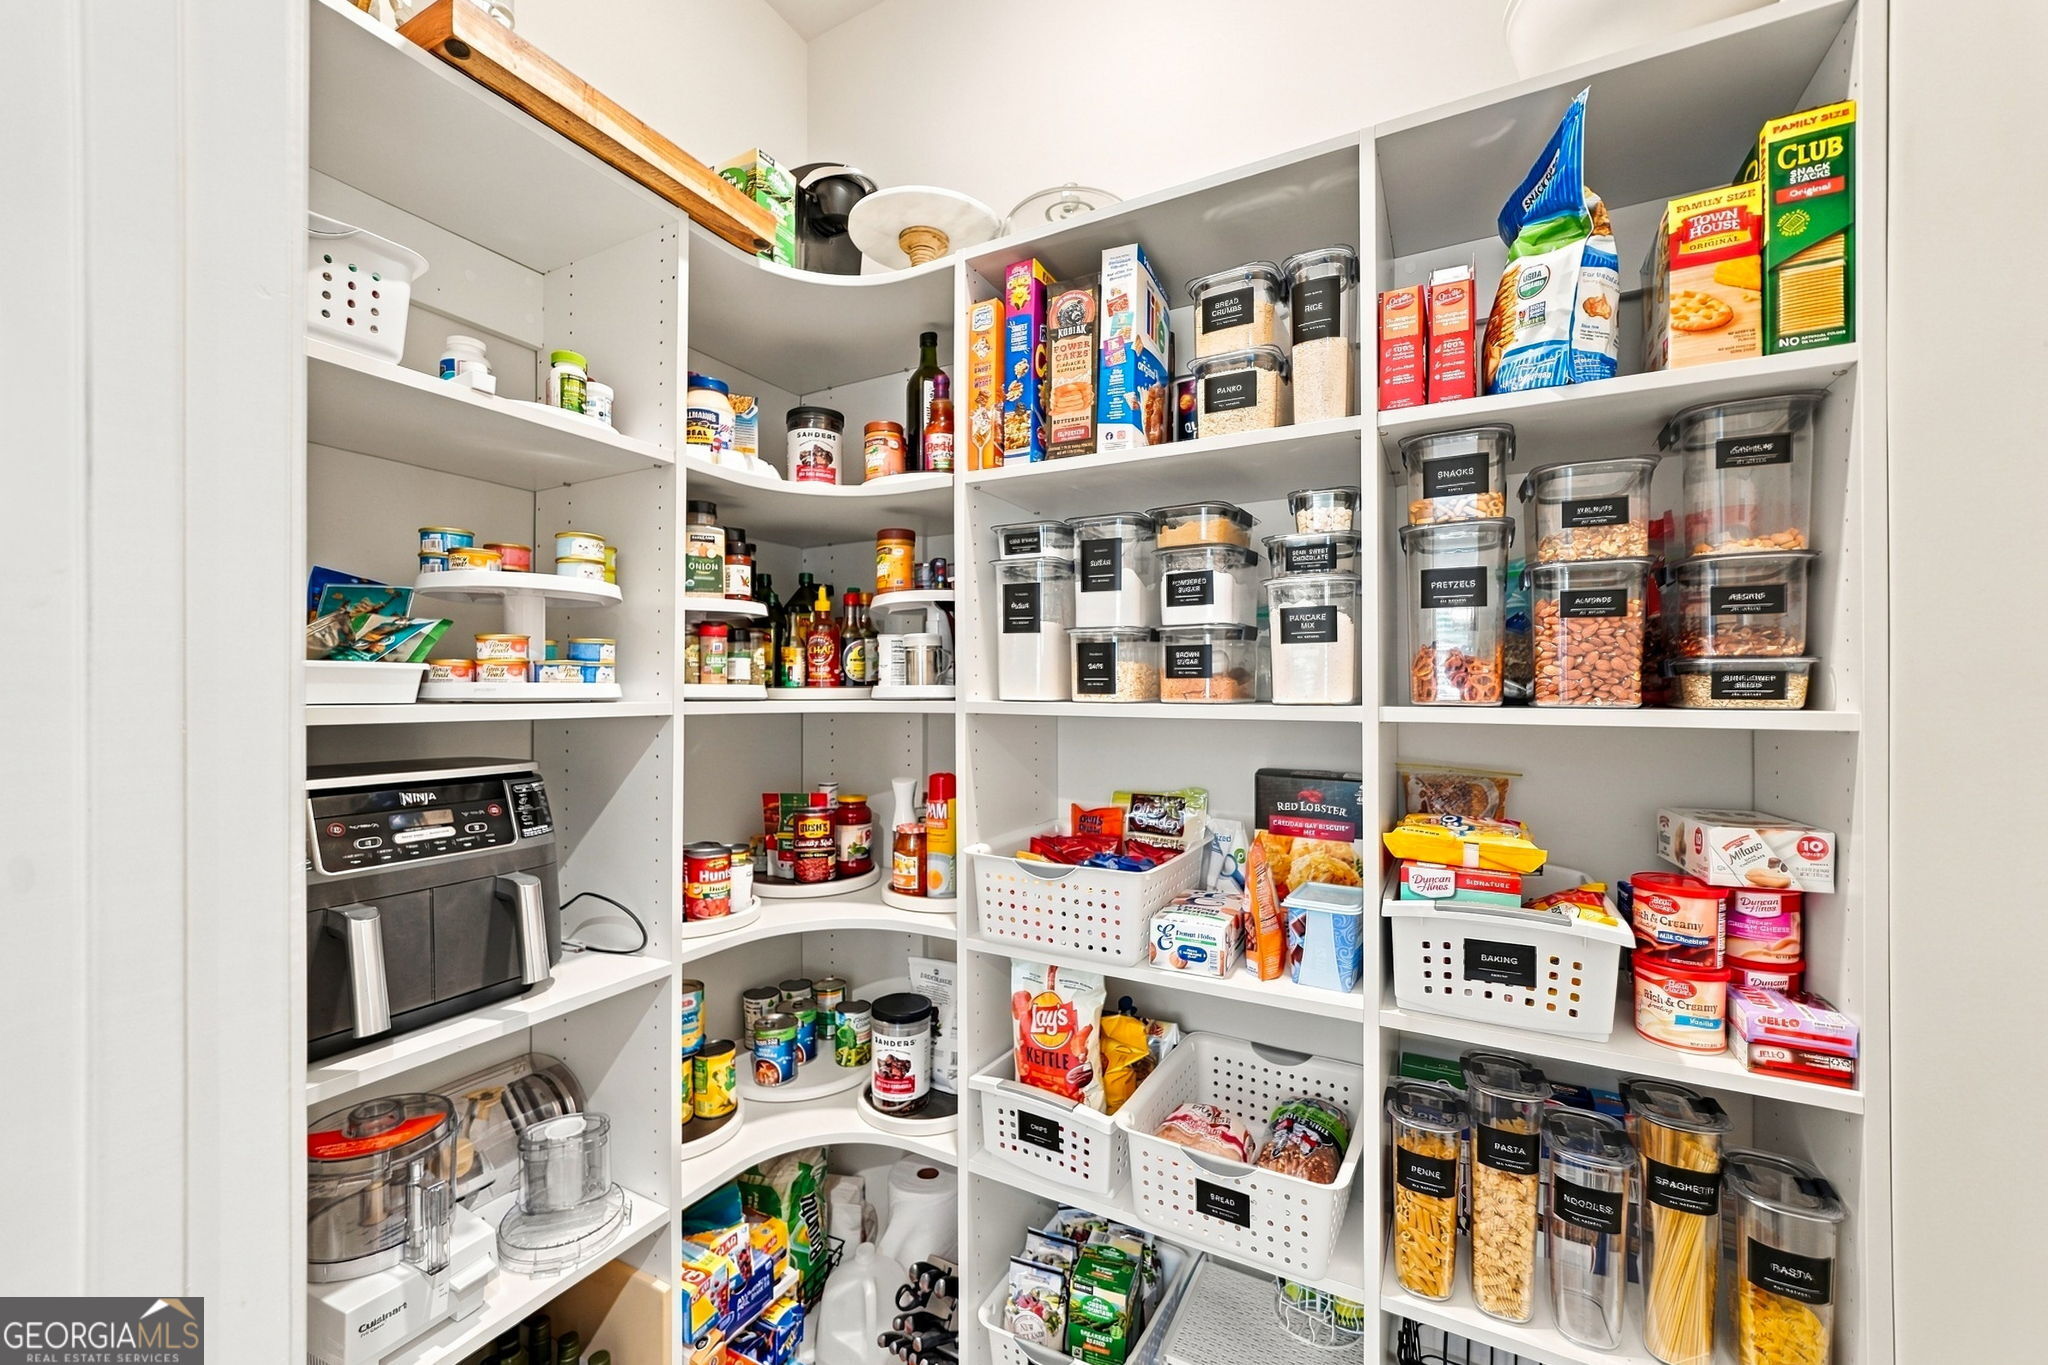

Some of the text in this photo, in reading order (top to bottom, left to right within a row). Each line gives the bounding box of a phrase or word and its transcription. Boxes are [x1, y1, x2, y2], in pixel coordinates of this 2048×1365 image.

[1772, 108, 1850, 134] FAMILY SIZE
[1777, 136, 1844, 170] CLUB
[1790, 162, 1830, 177] SNACK
[1790, 170, 1831, 184] STACKS
[1789, 182, 1832, 197] Original
[1676, 189, 1756, 214] FAMILY SIZE
[1688, 208, 1738, 227] TOWN
[1689, 218, 1740, 240] HOUSE
[1689, 236, 1740, 251] ORIGINAL
[1522, 270, 1542, 282] USDA
[1214, 298, 1240, 310] BREAD
[1304, 302, 1323, 312] RICE
[1212, 304, 1242, 318] CRUMBS
[1058, 324, 1087, 338] KODIAK
[1054, 341, 1090, 354] POWER
[1778, 337, 1800, 348] NO
[1056, 350, 1089, 362] CAKES
[1216, 384, 1242, 394] PANKO
[1053, 416, 1090, 424] BUTTERMILK
[796, 432, 836, 442] SANDERS
[1436, 467, 1474, 478] SNACKS
[688, 562, 718, 571] ONION
[1090, 559, 1112, 567] SUGAR
[1430, 580, 1476, 590] PRETZELS
[1574, 596, 1612, 604] ALMONDS
[1290, 614, 1326, 622] PANCAKE
[400, 792, 436, 806] NINJA
[926, 803, 947, 820] PAM
[1276, 801, 1348, 818] RED LOBSTER
[800, 824, 828, 832] BUSH'S
[1272, 820, 1303, 828] CHEDDAR
[1802, 840, 1824, 852] 10
[1729, 842, 1763, 866] Milano
[1412, 874, 1451, 885] Duncan
[1466, 878, 1510, 889] SIGNATURE
[1416, 882, 1448, 892] Hines
[1740, 896, 1778, 906] Duncan
[1744, 904, 1778, 912] Hines
[1660, 916, 1704, 932] Creamy
[1176, 930, 1196, 938] Donut
[1480, 953, 1518, 966] BAKING
[1750, 978, 1788, 988] Duncan
[1644, 990, 1718, 1015] Rich & Creamy
[1032, 1003, 1069, 1035] Lay's
[1688, 1018, 1714, 1027] Vanilla
[874, 1036, 914, 1047] SANDERS
[1026, 1047, 1070, 1070] KETTLE
[1030, 1123, 1048, 1134] CHIPS
[1494, 1142, 1526, 1156] PASTA
[1411, 1165, 1440, 1180] PENNE
[1654, 1175, 1715, 1195] SPAGHETTI
[1210, 1193, 1236, 1206] BREAD
[1564, 1194, 1614, 1215] NOODLES
[800, 1191, 824, 1266] Bounty
[1770, 1262, 1812, 1281] PASTA
[358, 1302, 408, 1334] Cuisinart
[1080, 1329, 1113, 1343] BREAKFAST
